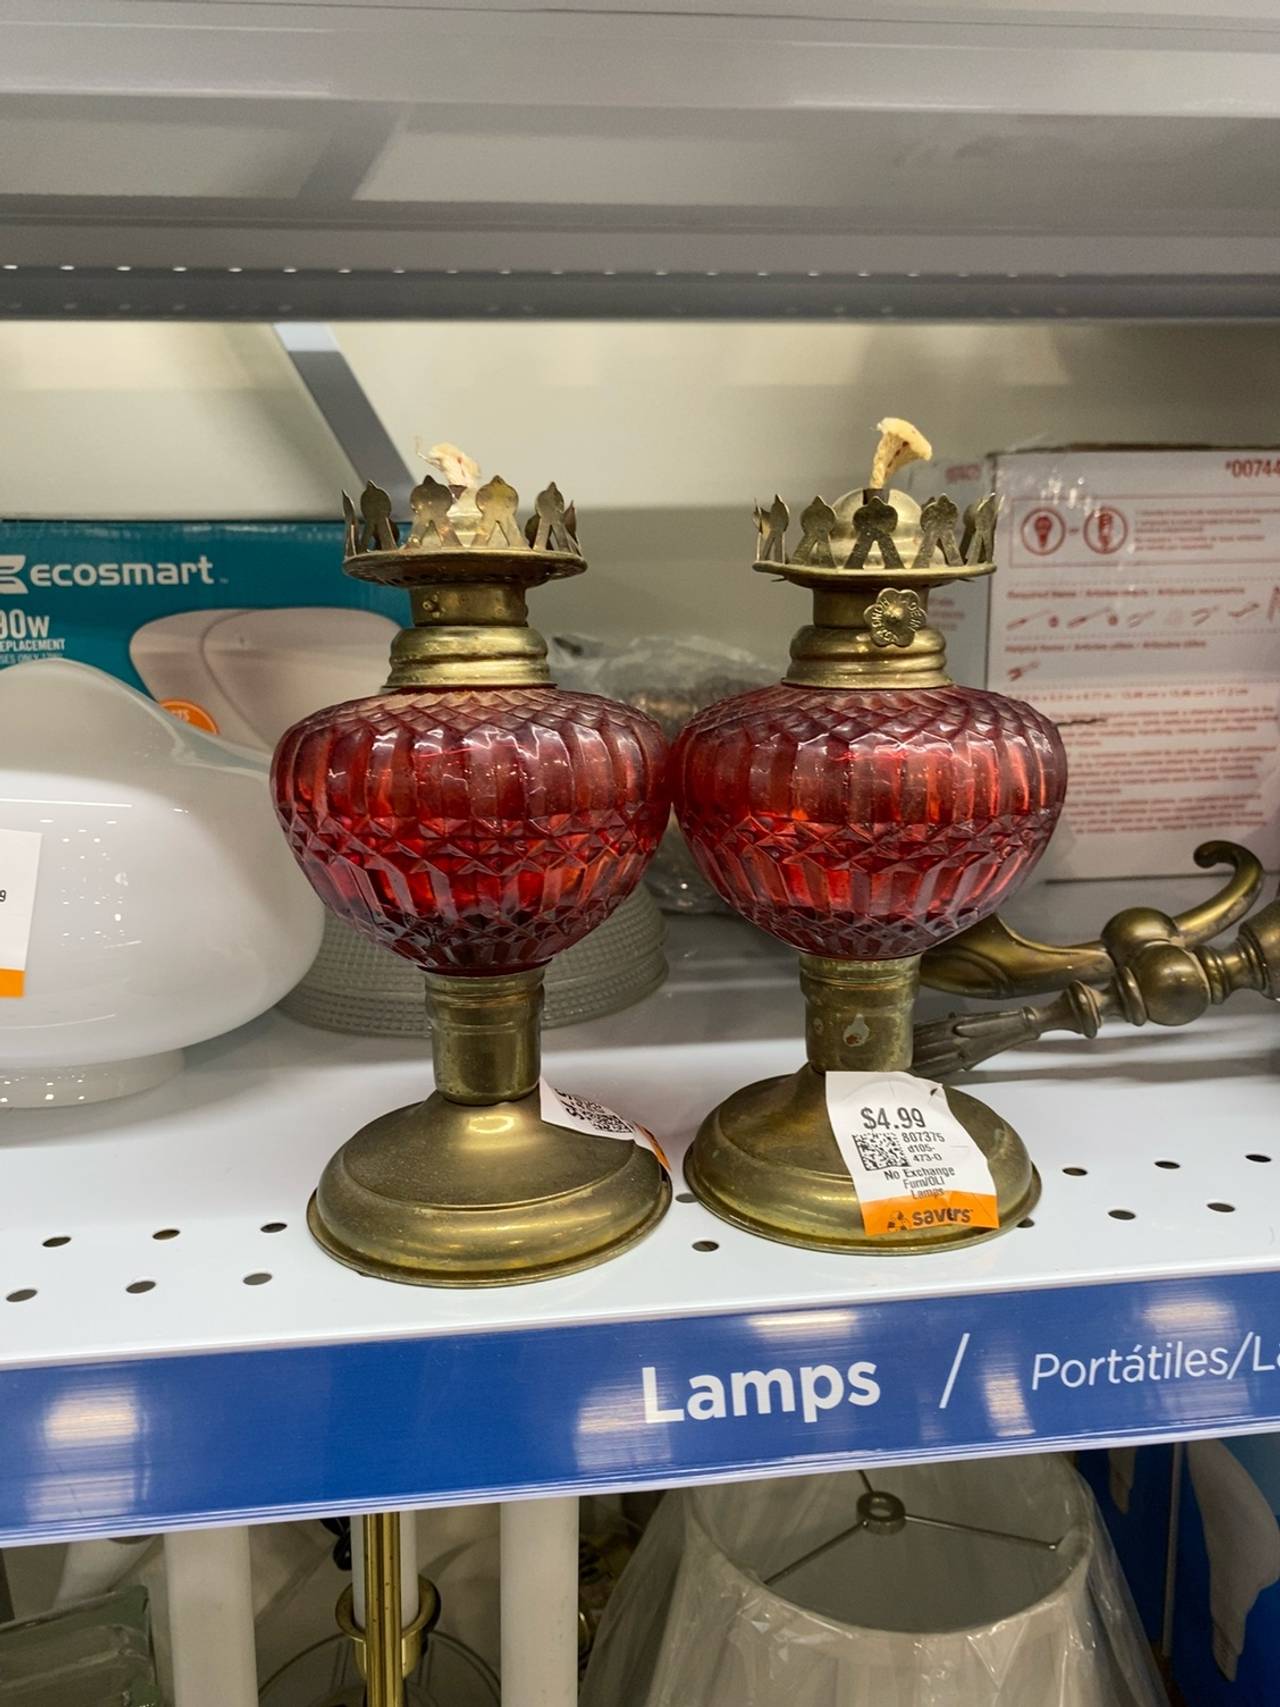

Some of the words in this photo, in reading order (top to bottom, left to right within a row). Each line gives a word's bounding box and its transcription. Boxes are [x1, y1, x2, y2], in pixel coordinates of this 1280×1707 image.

[30, 555, 214, 587] ecosmart
[860, 1106, 926, 1130] $4.99
[901, 1131, 945, 1143] 807375
[883, 1169, 900, 1181] No
[902, 1166, 956, 1178] Exchange
[911, 1187, 945, 1200] Lamps
[642, 1361, 881, 1424] Lamps
[1032, 1331, 1280, 1391] Portátiles/L
